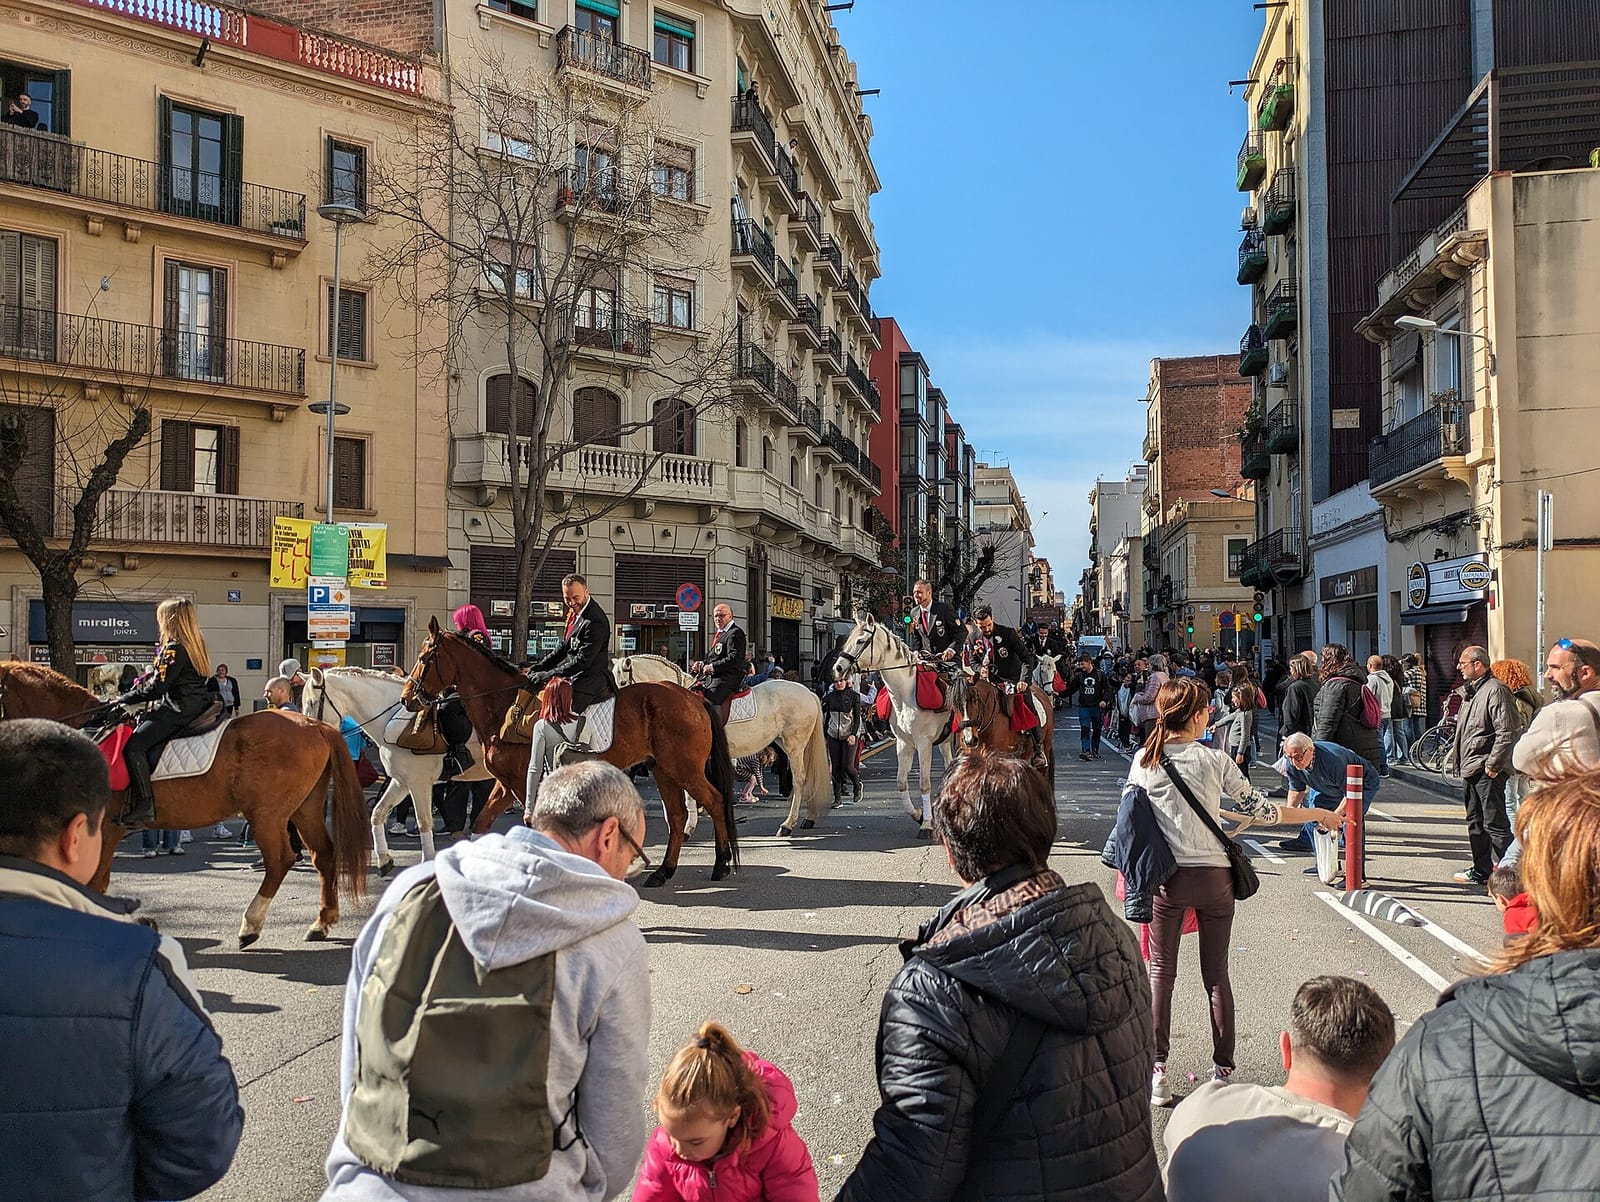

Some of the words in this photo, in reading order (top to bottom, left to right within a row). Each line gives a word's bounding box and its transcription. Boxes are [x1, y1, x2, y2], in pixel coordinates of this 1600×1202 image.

[314, 588, 325, 602] P
[78, 618, 130, 627] miralles
[113, 626, 138, 636] joiers
